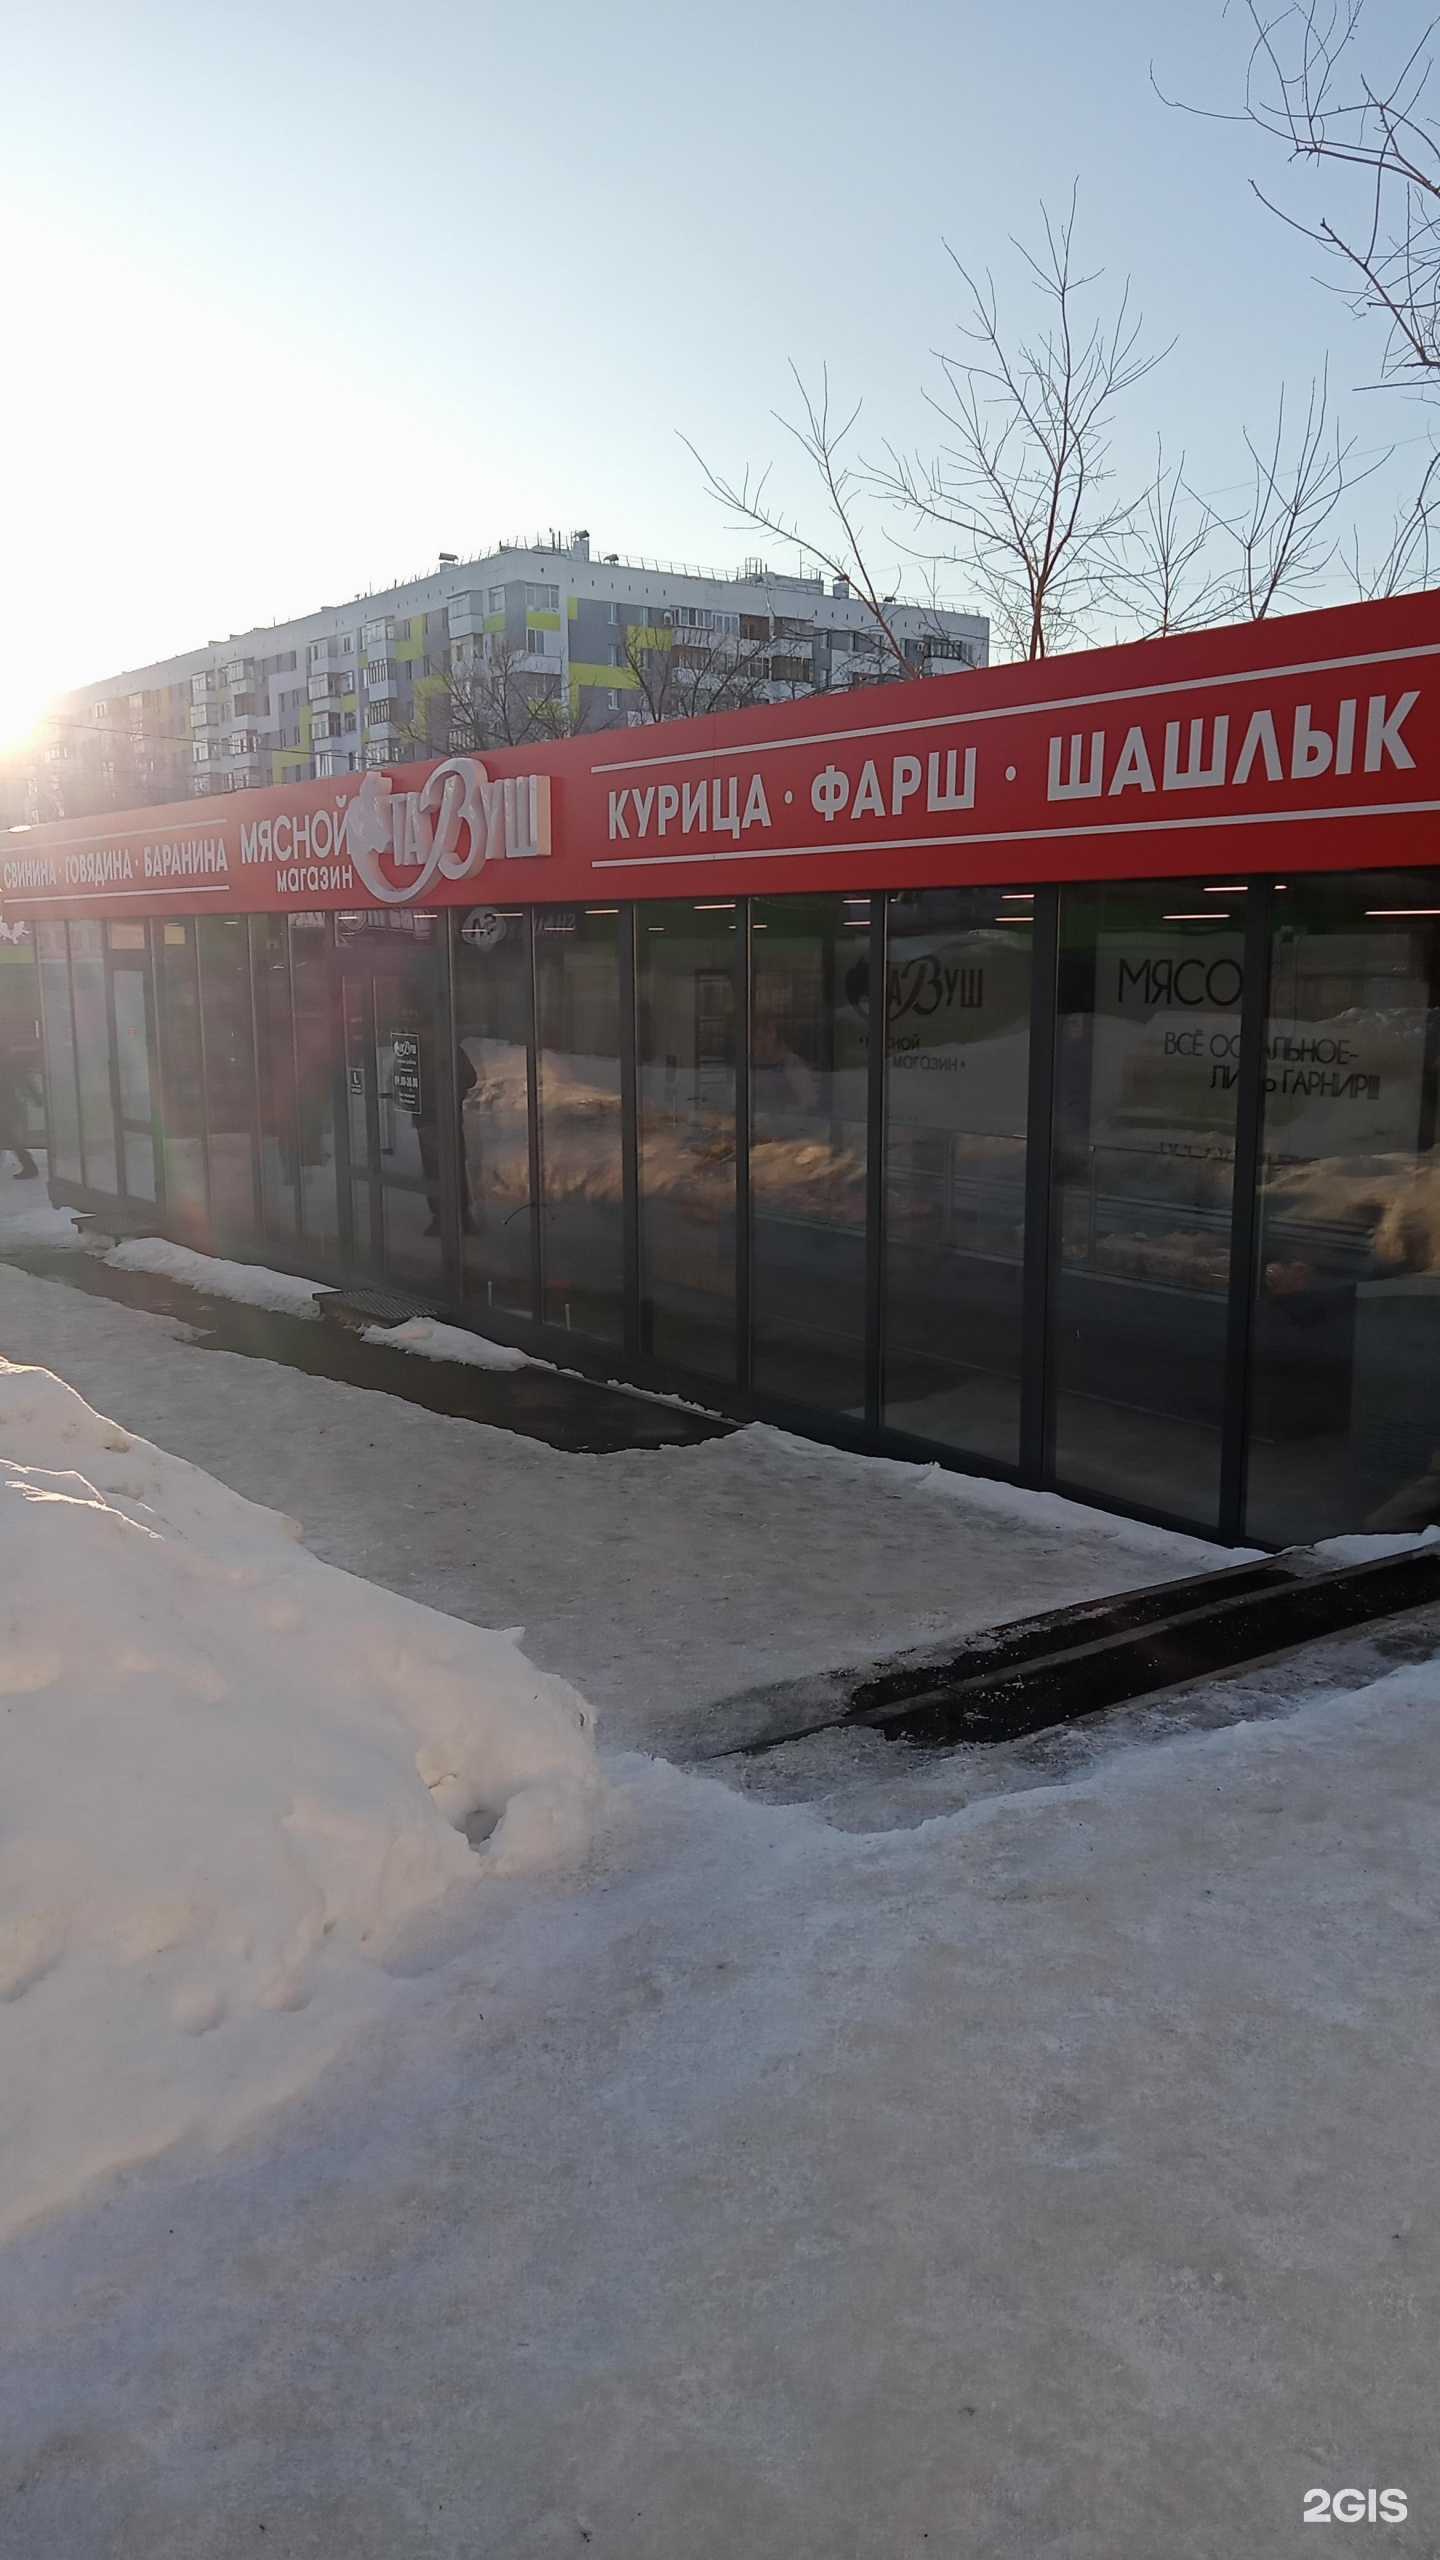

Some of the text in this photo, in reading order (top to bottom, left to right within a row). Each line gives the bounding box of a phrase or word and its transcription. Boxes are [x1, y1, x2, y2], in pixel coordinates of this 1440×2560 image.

[608, 690, 1421, 840] КУРИЦА ФАРШ ШАШЛЫК
[240, 795, 351, 864] МЯСНОЙ
[3, 838, 229, 889] СВИНИНА ГОВЯДИНА БАРАНИНА
[276, 864, 353, 893] магазин
[1117, 958, 1243, 1006] МЯСО
[1164, 1029, 1204, 1056] ВСЁ
[1209, 1065, 1277, 1093] ЛИЬ
